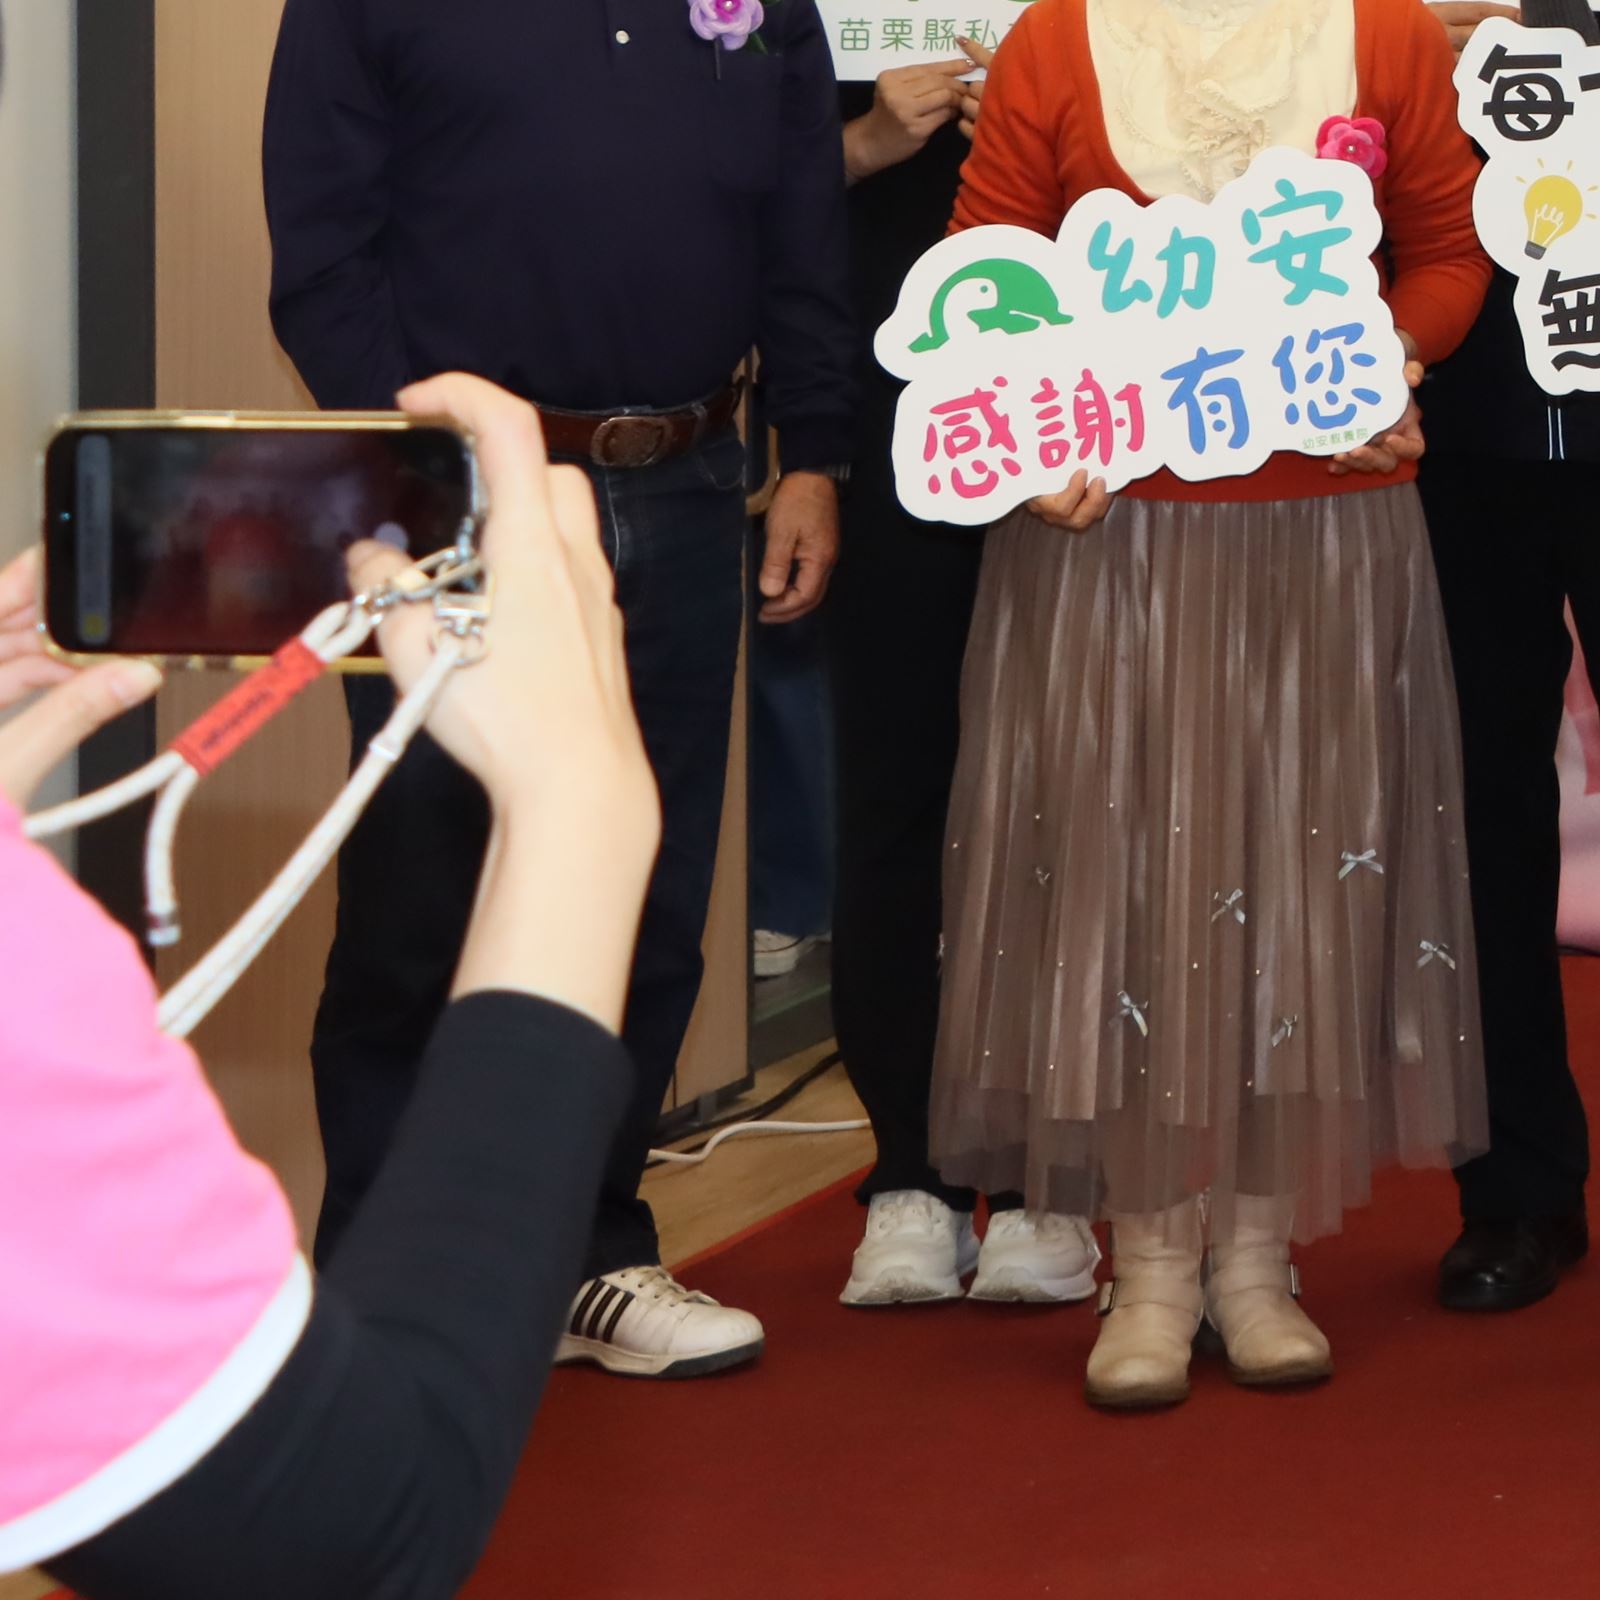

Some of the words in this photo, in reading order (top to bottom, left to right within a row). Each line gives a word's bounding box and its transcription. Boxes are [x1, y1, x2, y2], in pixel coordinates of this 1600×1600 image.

[838, 18, 1014, 52] 苗栗縣私
[1088, 179, 1352, 318] 幼安
[923, 322, 1382, 499] 感謝有您
